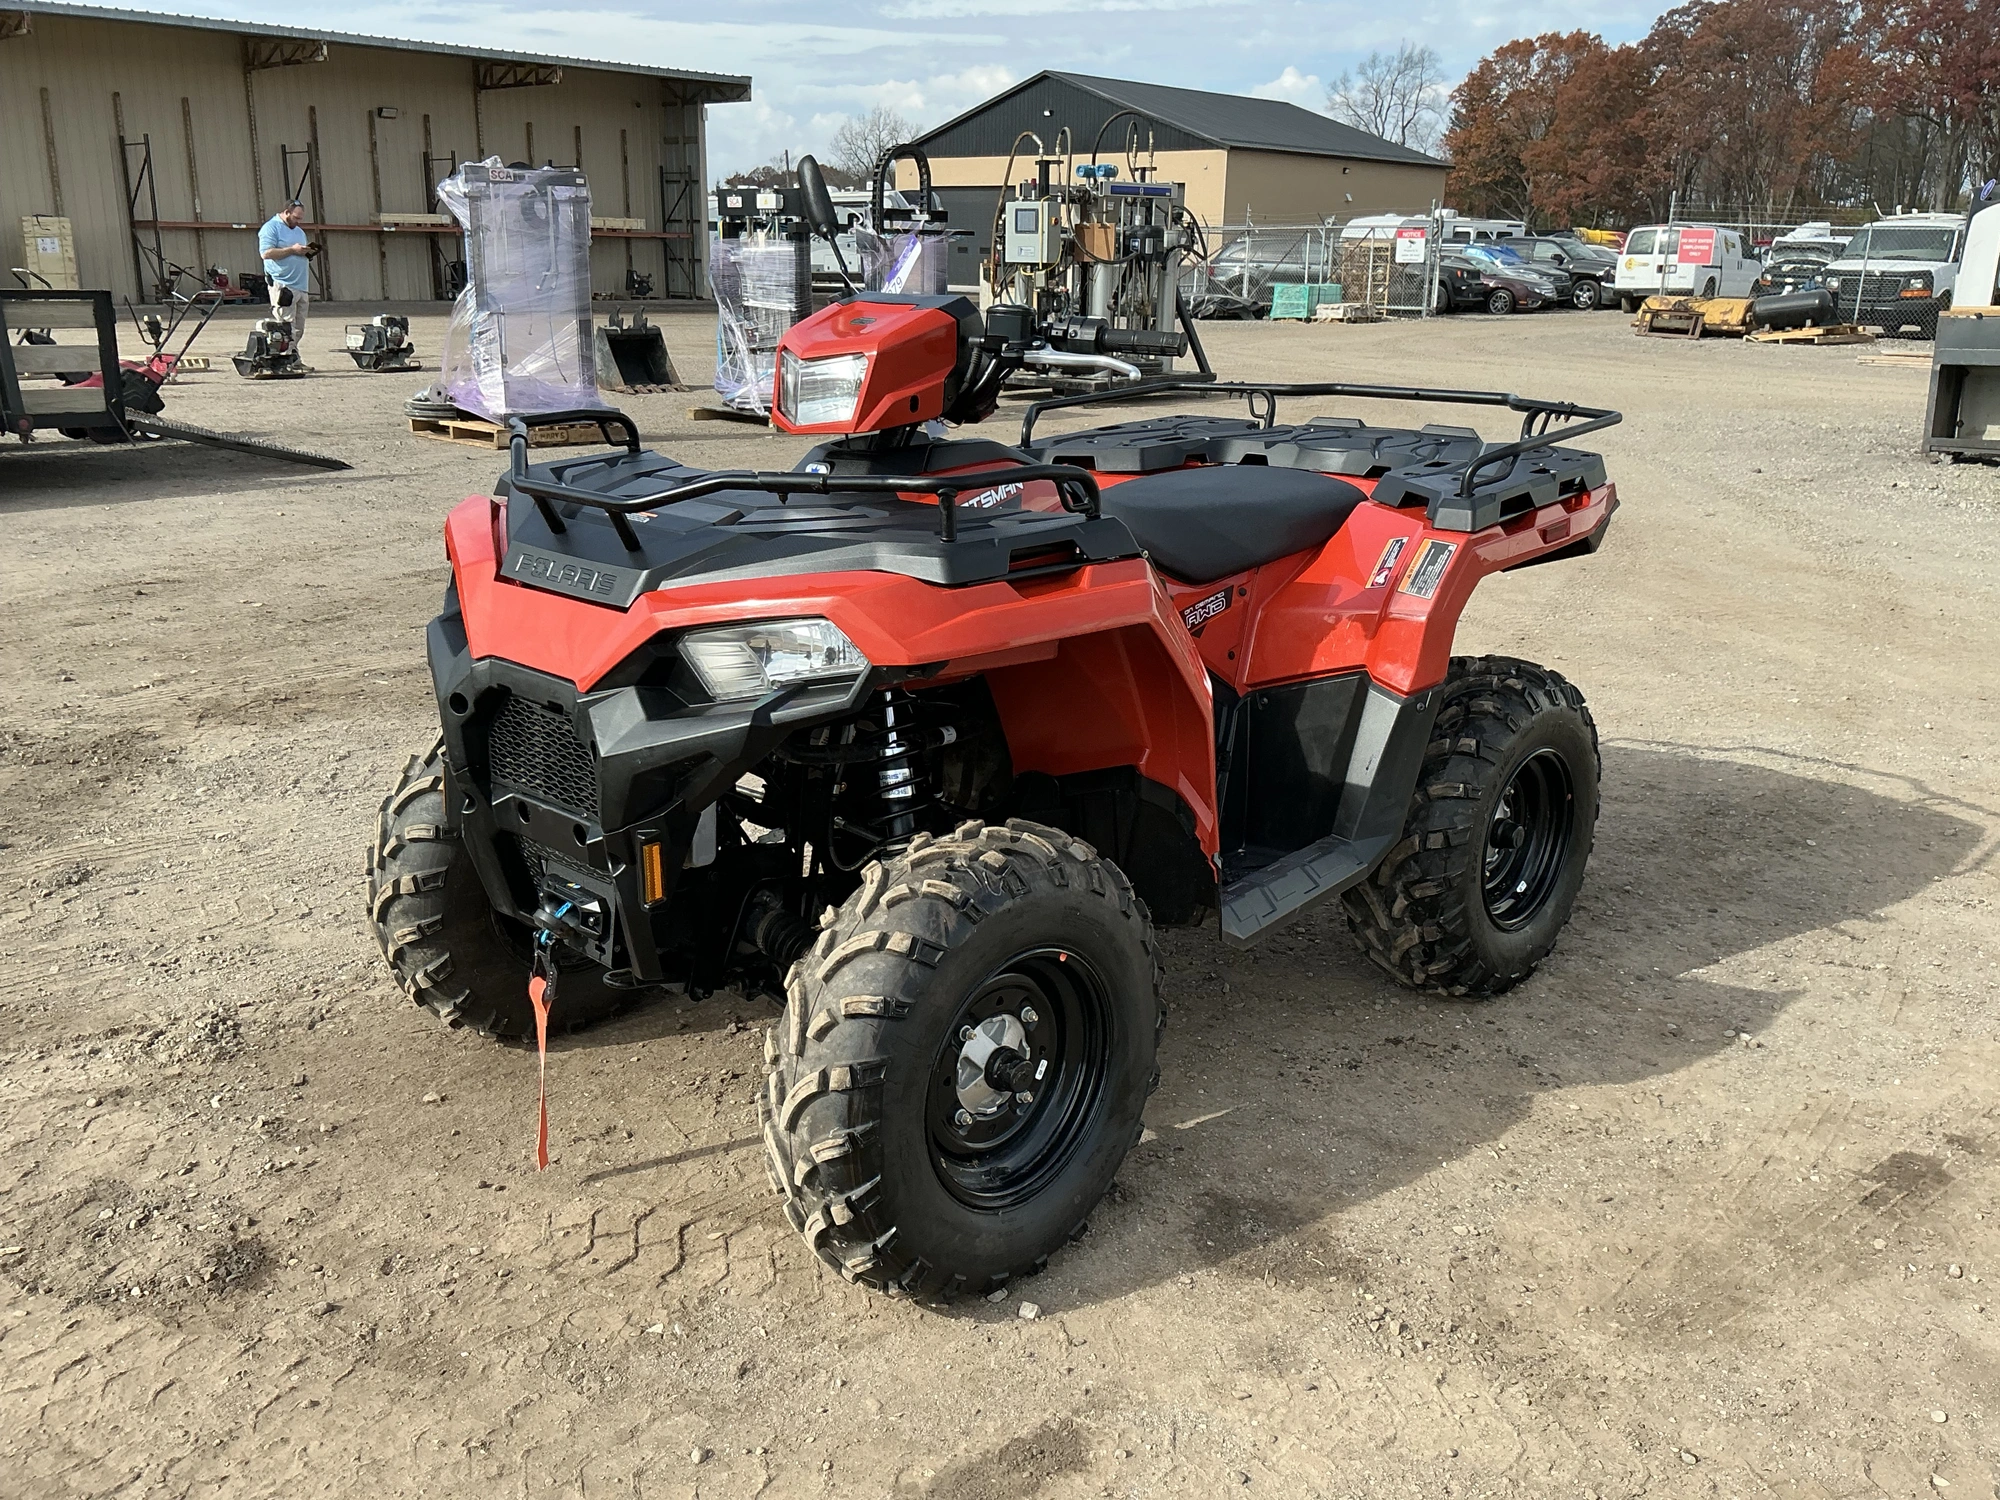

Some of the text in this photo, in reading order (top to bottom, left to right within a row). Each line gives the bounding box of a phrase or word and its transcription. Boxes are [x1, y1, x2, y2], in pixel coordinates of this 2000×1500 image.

[490, 169, 513, 181] SCA
[729, 197, 740, 207] SCA
[515, 553, 617, 596] POLARIS
[1186, 597, 1226, 629] AWD
